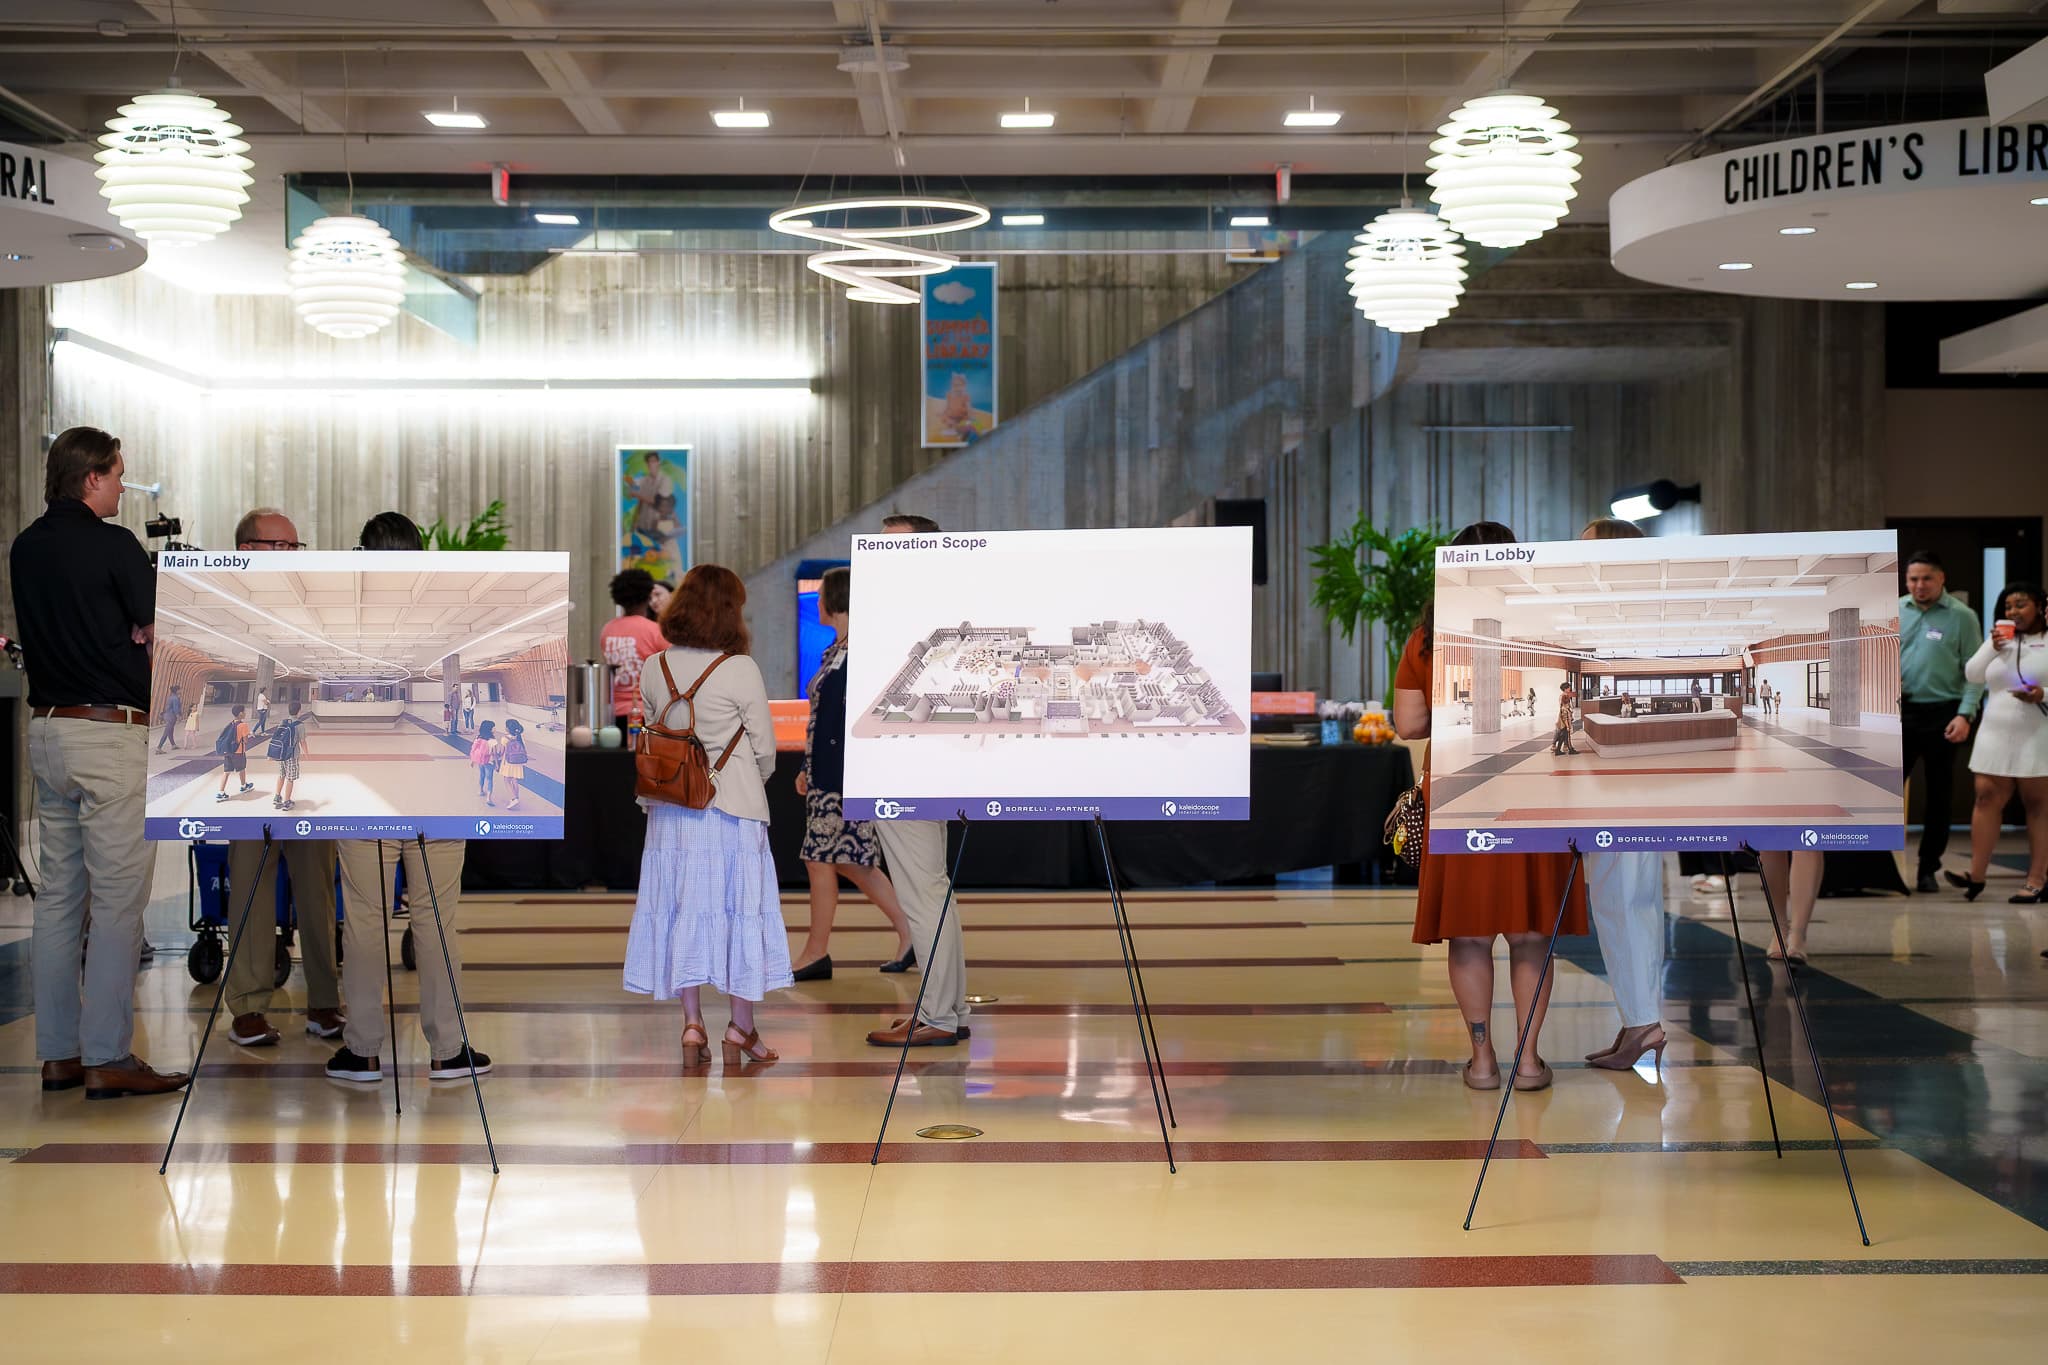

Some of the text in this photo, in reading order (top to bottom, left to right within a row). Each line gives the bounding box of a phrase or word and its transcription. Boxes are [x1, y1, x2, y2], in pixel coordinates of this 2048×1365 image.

[1724, 123, 2048, 205] CHILDREN'S LIBR
[0, 152, 55, 206] RAL
[925, 343, 991, 359] LIBRARY
[857, 536, 987, 551] Renovation Scope
[164, 555, 250, 570] Main Lobby
[1442, 547, 1536, 563] Main Lobby
[1178, 803, 1220, 811] kaleidoscope
[492, 823, 534, 832] kaleidoscope
[1820, 832, 1869, 841] kaleidoscope
